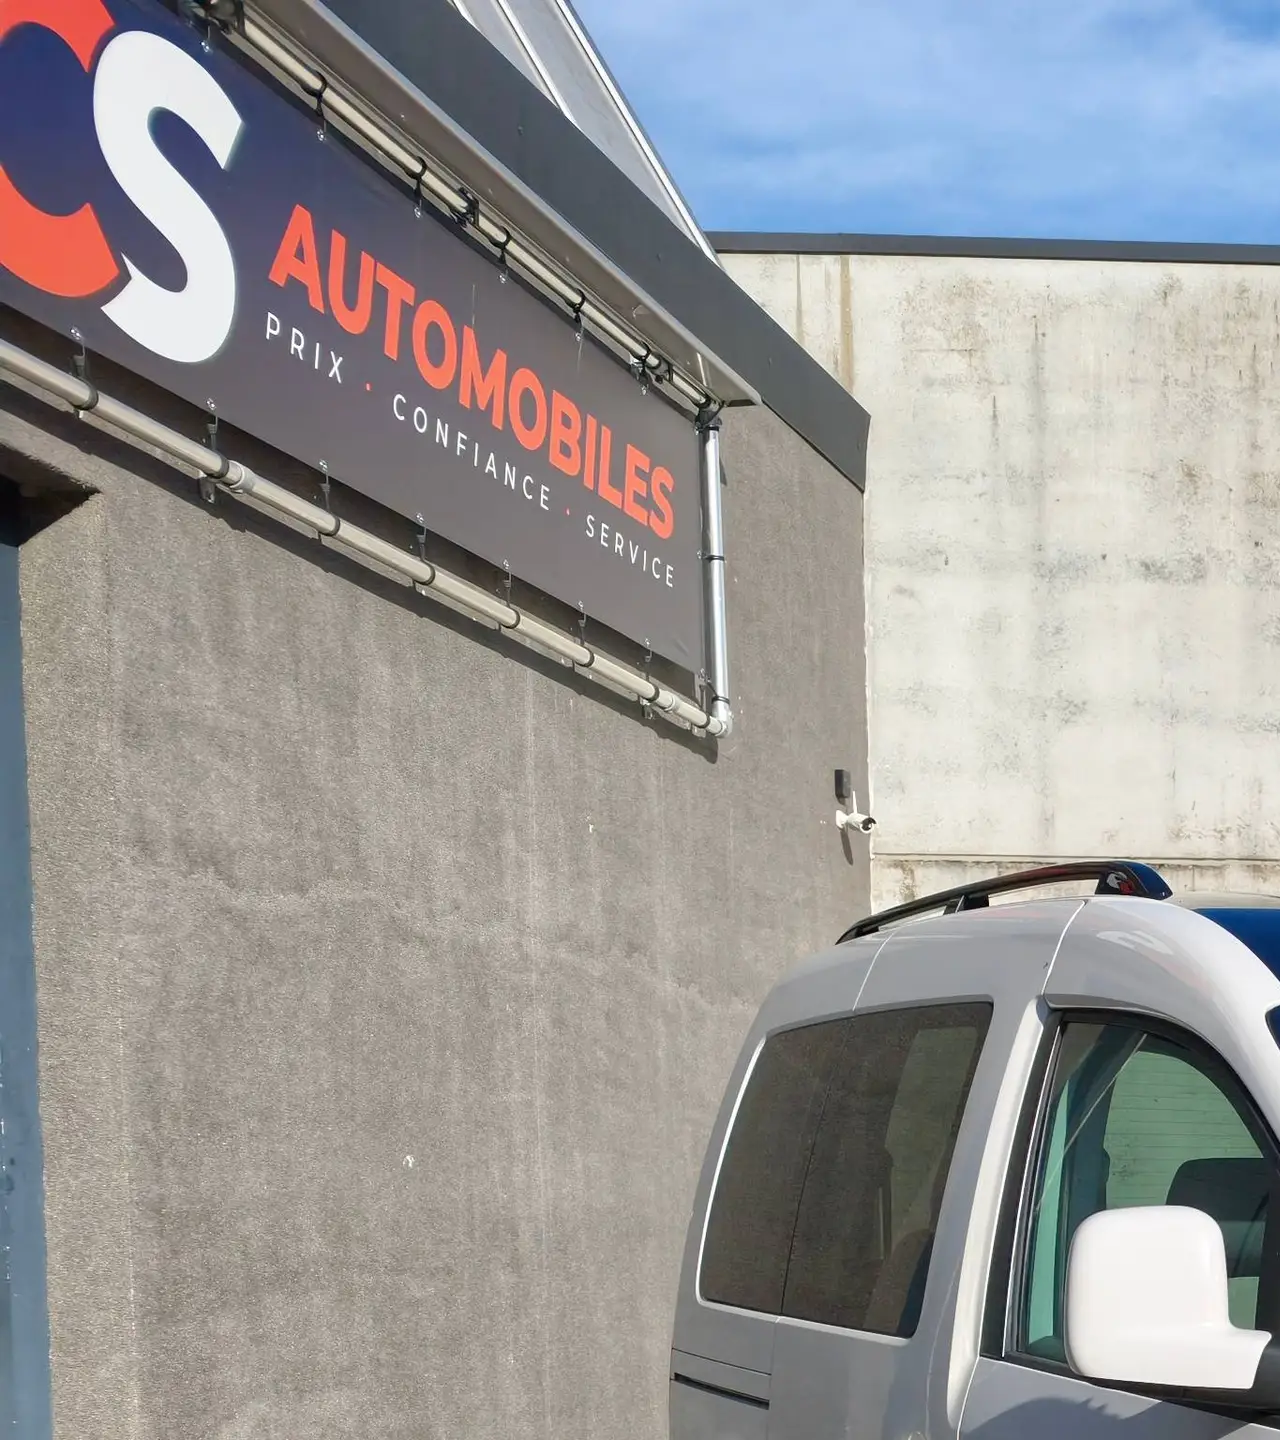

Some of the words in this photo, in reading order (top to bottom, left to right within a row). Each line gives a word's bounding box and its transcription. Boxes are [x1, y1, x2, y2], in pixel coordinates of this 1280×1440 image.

[265, 311, 344, 384] PRIX
[392, 393, 550, 511] CONFIANCE
[584, 515, 675, 588] SERVICE
[268, 203, 675, 539] AUTOMOBILES
